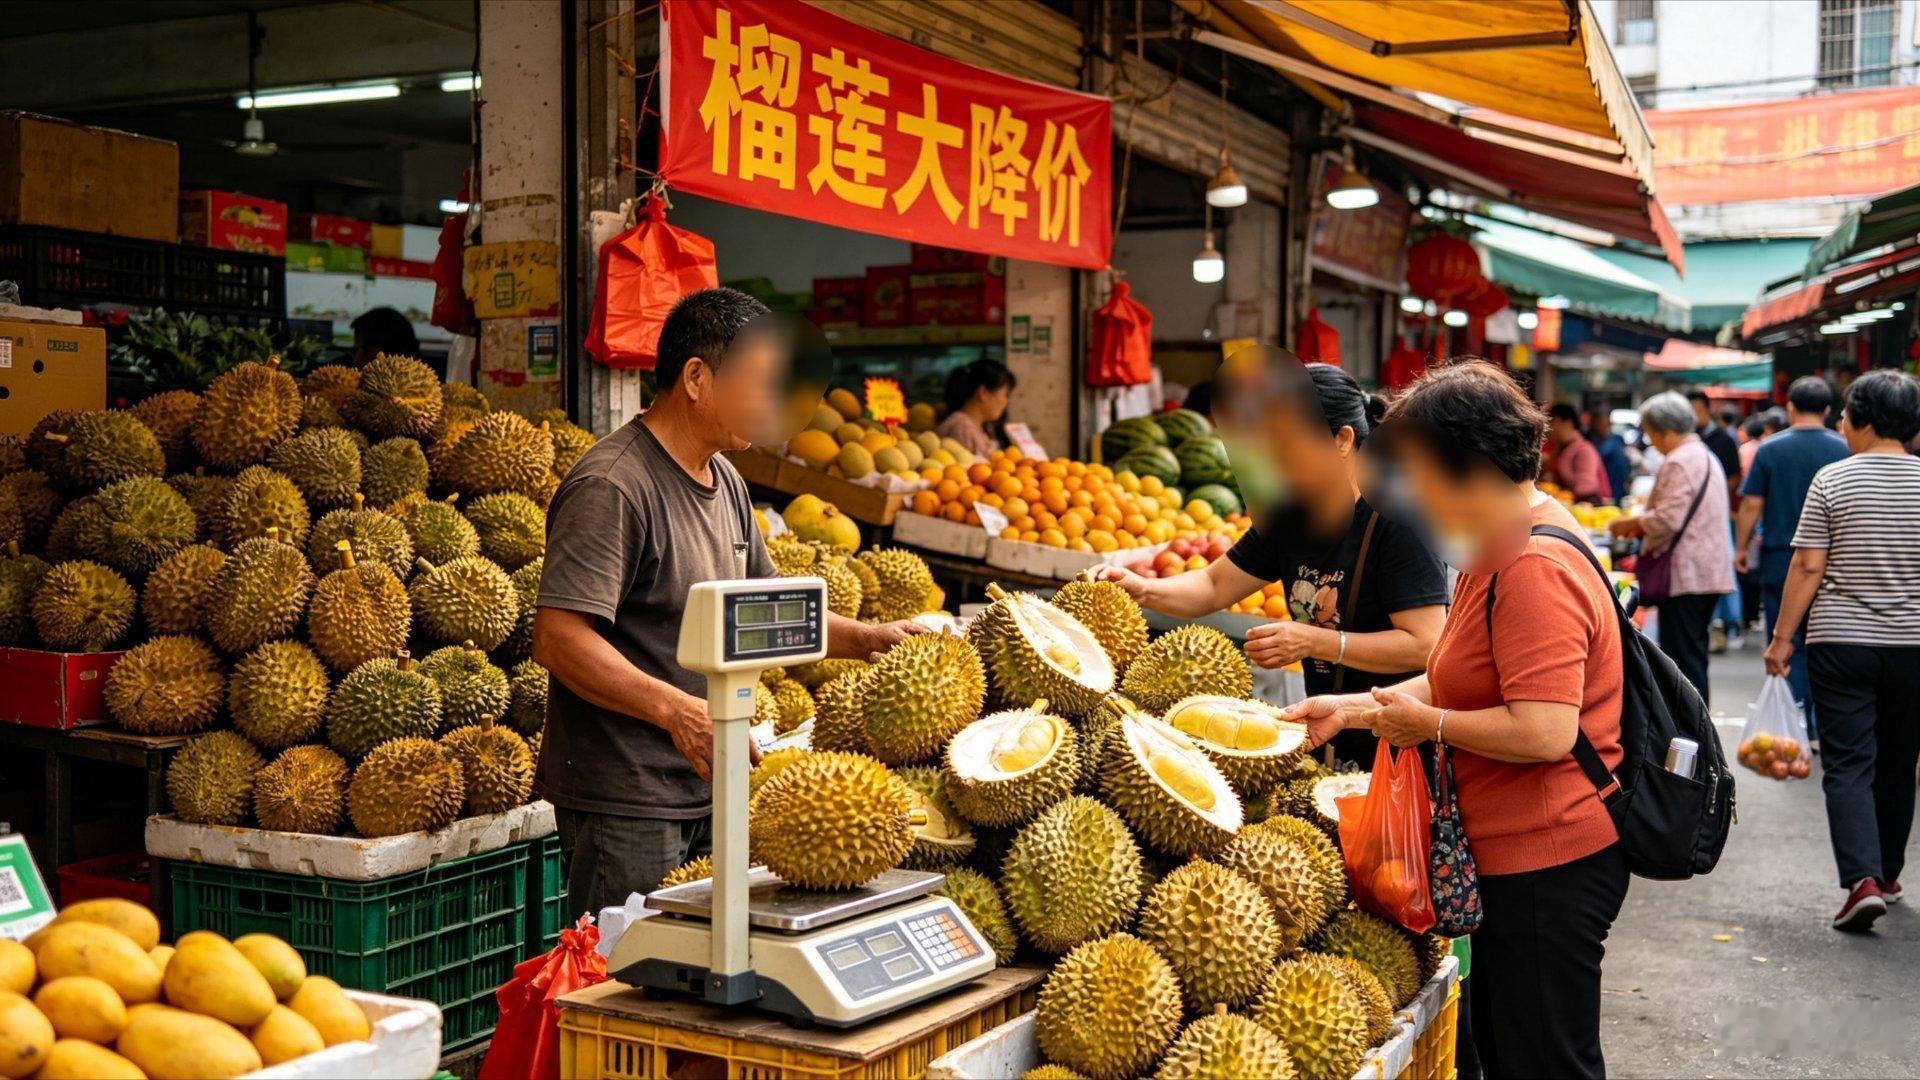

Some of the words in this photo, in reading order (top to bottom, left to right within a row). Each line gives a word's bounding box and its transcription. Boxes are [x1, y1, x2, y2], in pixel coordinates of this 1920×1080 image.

[699, 8, 1092, 247] 榴莲大降价
